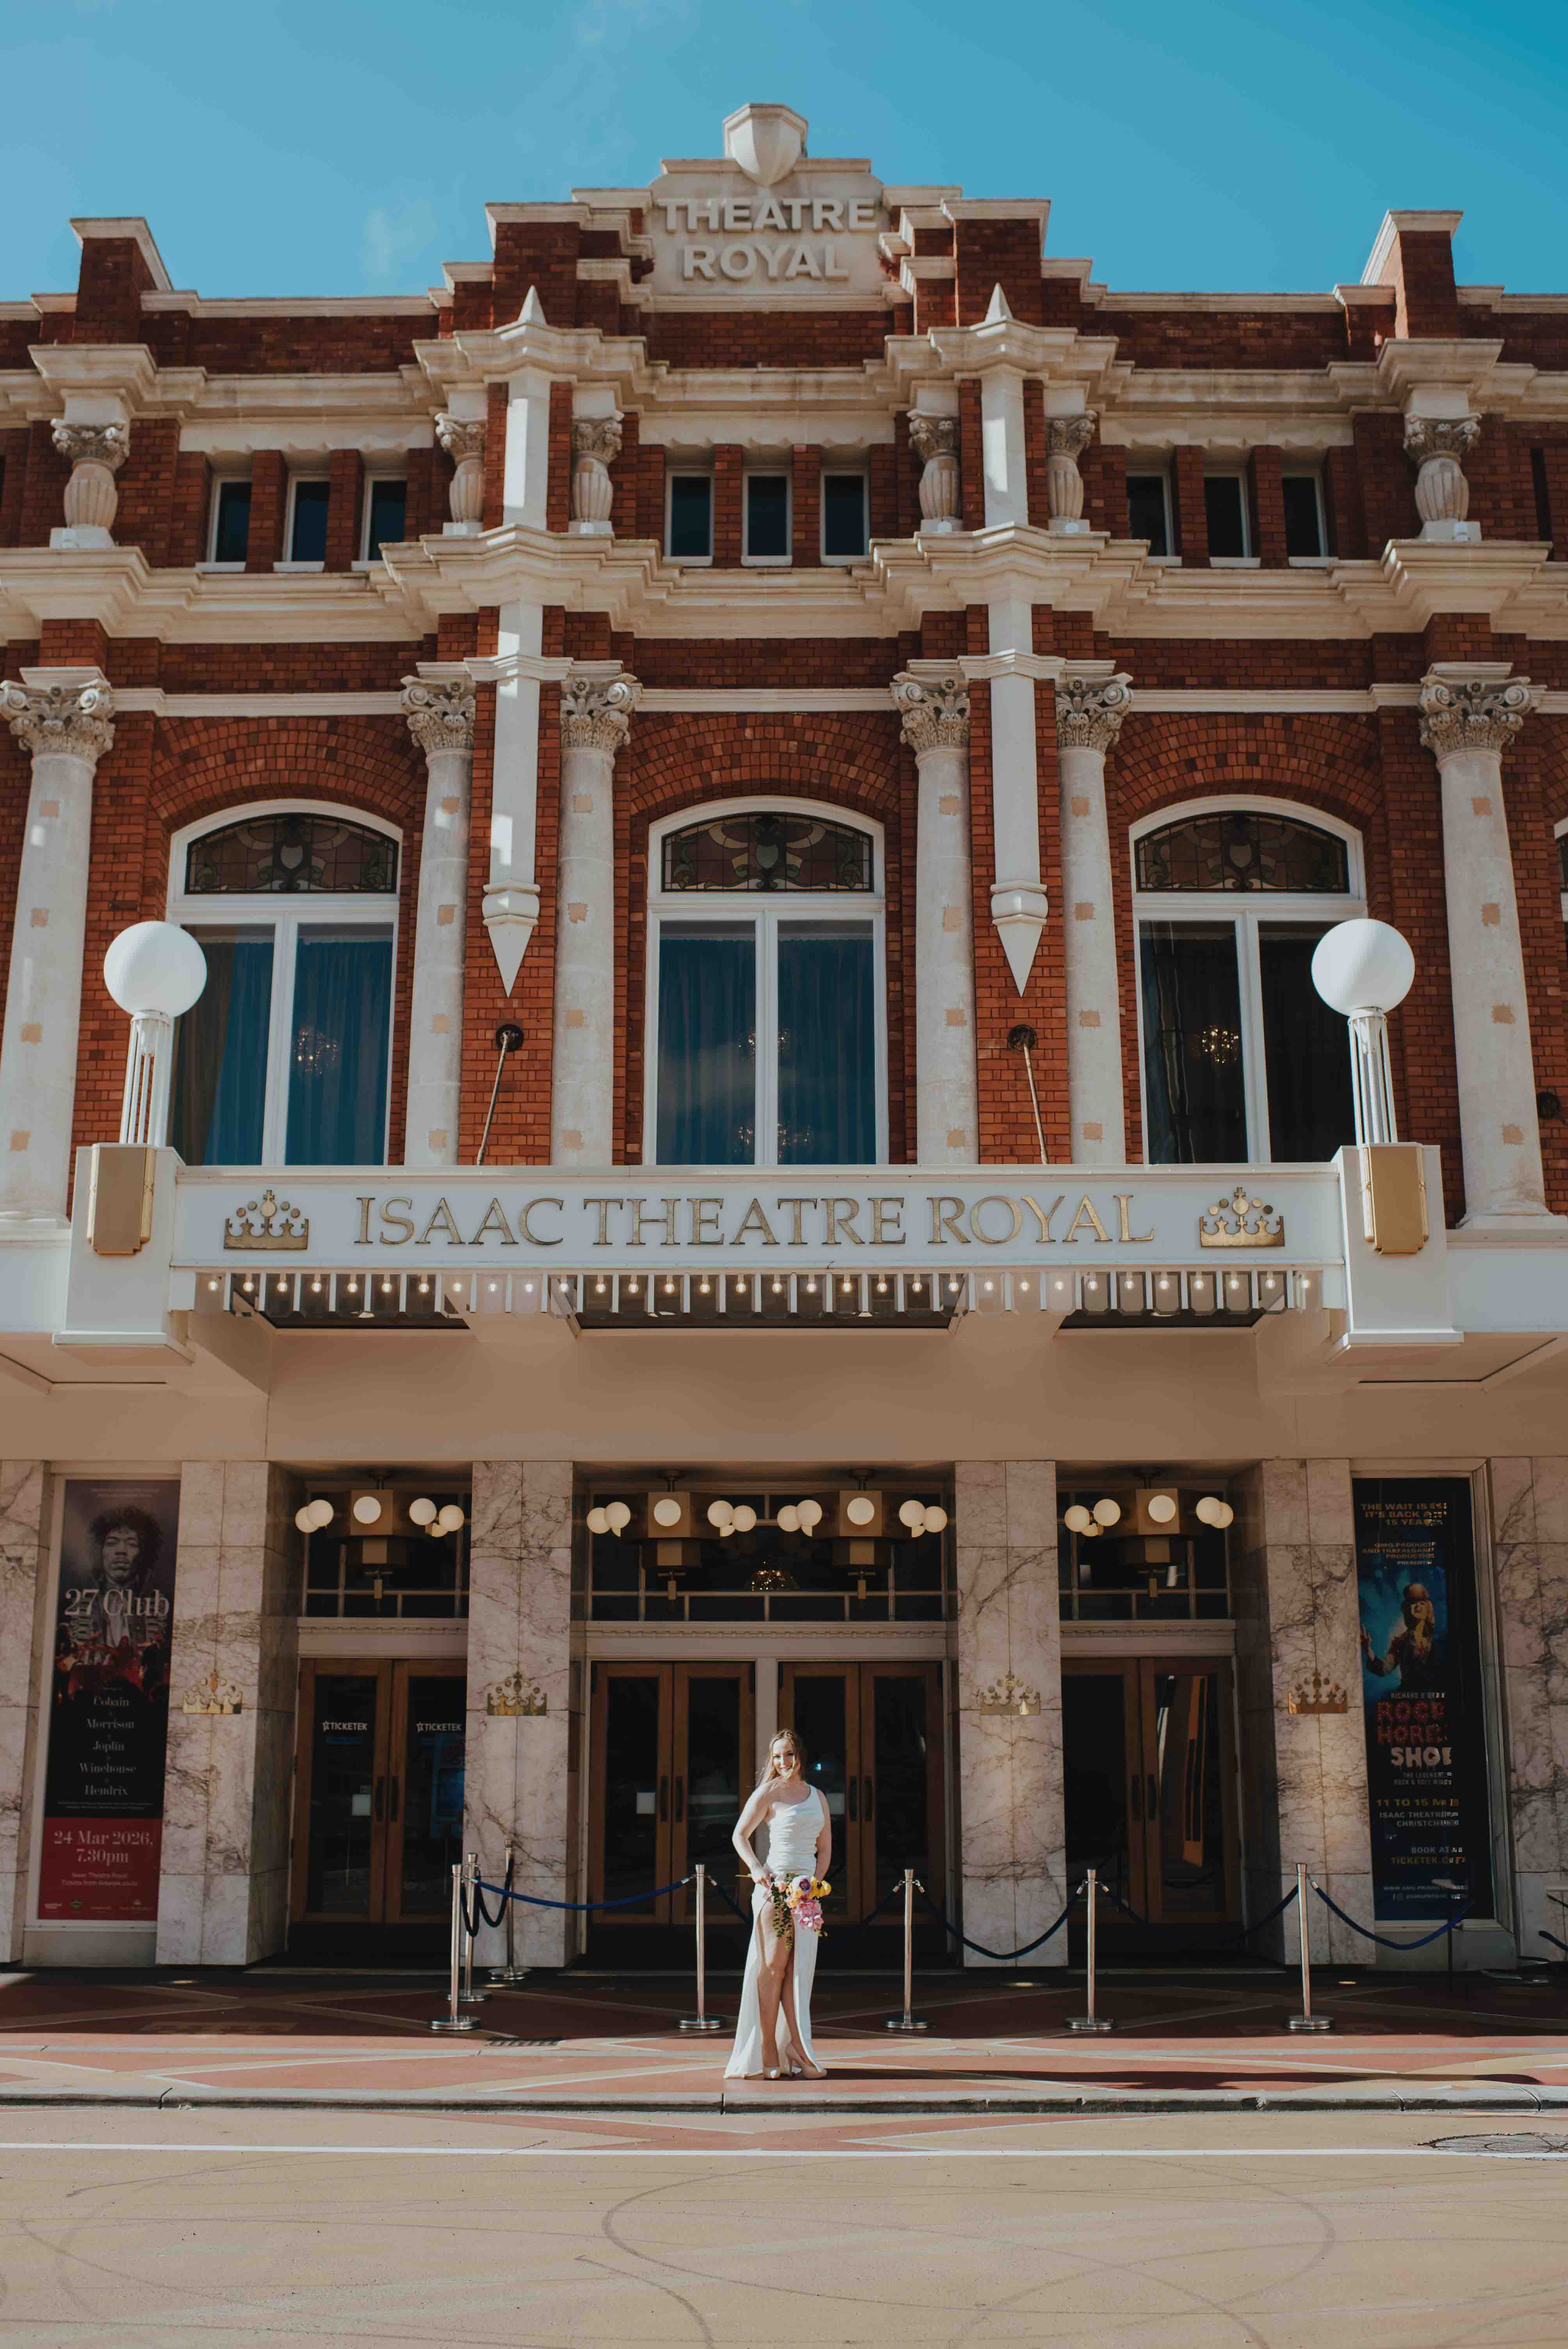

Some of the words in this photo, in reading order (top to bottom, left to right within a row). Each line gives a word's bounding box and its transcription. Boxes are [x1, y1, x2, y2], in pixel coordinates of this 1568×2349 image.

[656, 198, 877, 232] THEATRE
[683, 244, 850, 280] ROYAL
[354, 1197, 565, 1246] ISAAC
[583, 1197, 907, 1246] THEATRE
[926, 1195, 1155, 1244] ROYAL
[64, 1588, 100, 1616] 27
[103, 1588, 169, 1617] Club
[93, 1696, 130, 1706] Cobain
[86, 1718, 135, 1729] Morrison
[330, 1722, 369, 1731] TICKETEK
[424, 1722, 462, 1731] TICKETEK
[92, 1740, 125, 1753] Joplin
[79, 1762, 137, 1774] Winehouse
[84, 1784, 128, 1796] Hendrix
[1376, 1798, 1390, 1807] 11
[1393, 1798, 1411, 1807] TO
[53, 1830, 73, 1845] 24
[78, 1830, 110, 1845] Mar
[76, 1848, 129, 1866] 7.30pm
